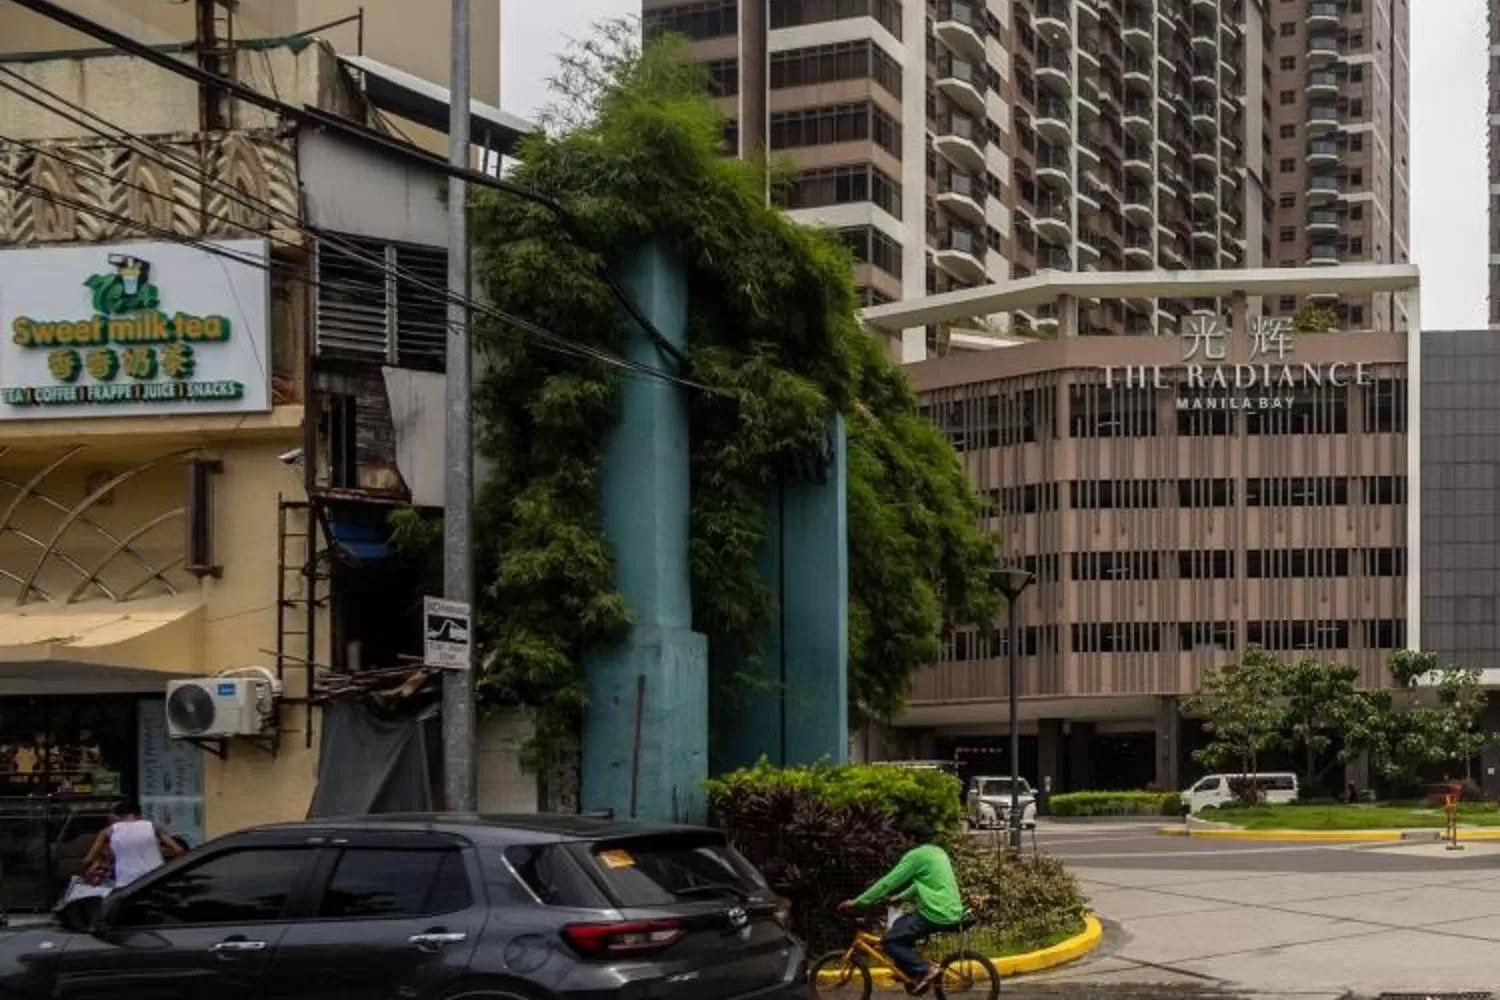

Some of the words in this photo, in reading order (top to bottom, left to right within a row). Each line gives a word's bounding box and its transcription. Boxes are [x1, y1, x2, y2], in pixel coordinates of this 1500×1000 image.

[12, 315, 102, 344] Sweet
[108, 311, 168, 341] milk
[175, 311, 223, 339] tea
[1181, 314, 1294, 361] 光辉
[1104, 366, 1171, 389] THE
[1187, 361, 1375, 389] RADIANCE
[35, 386, 77, 401] COFFEE
[88, 384, 131, 400] FRAPPE
[143, 383, 175, 399] JUICE
[187, 381, 235, 398] SNACKS
[1176, 397, 1251, 409] MANILA
[1259, 396, 1295, 409] BAY
